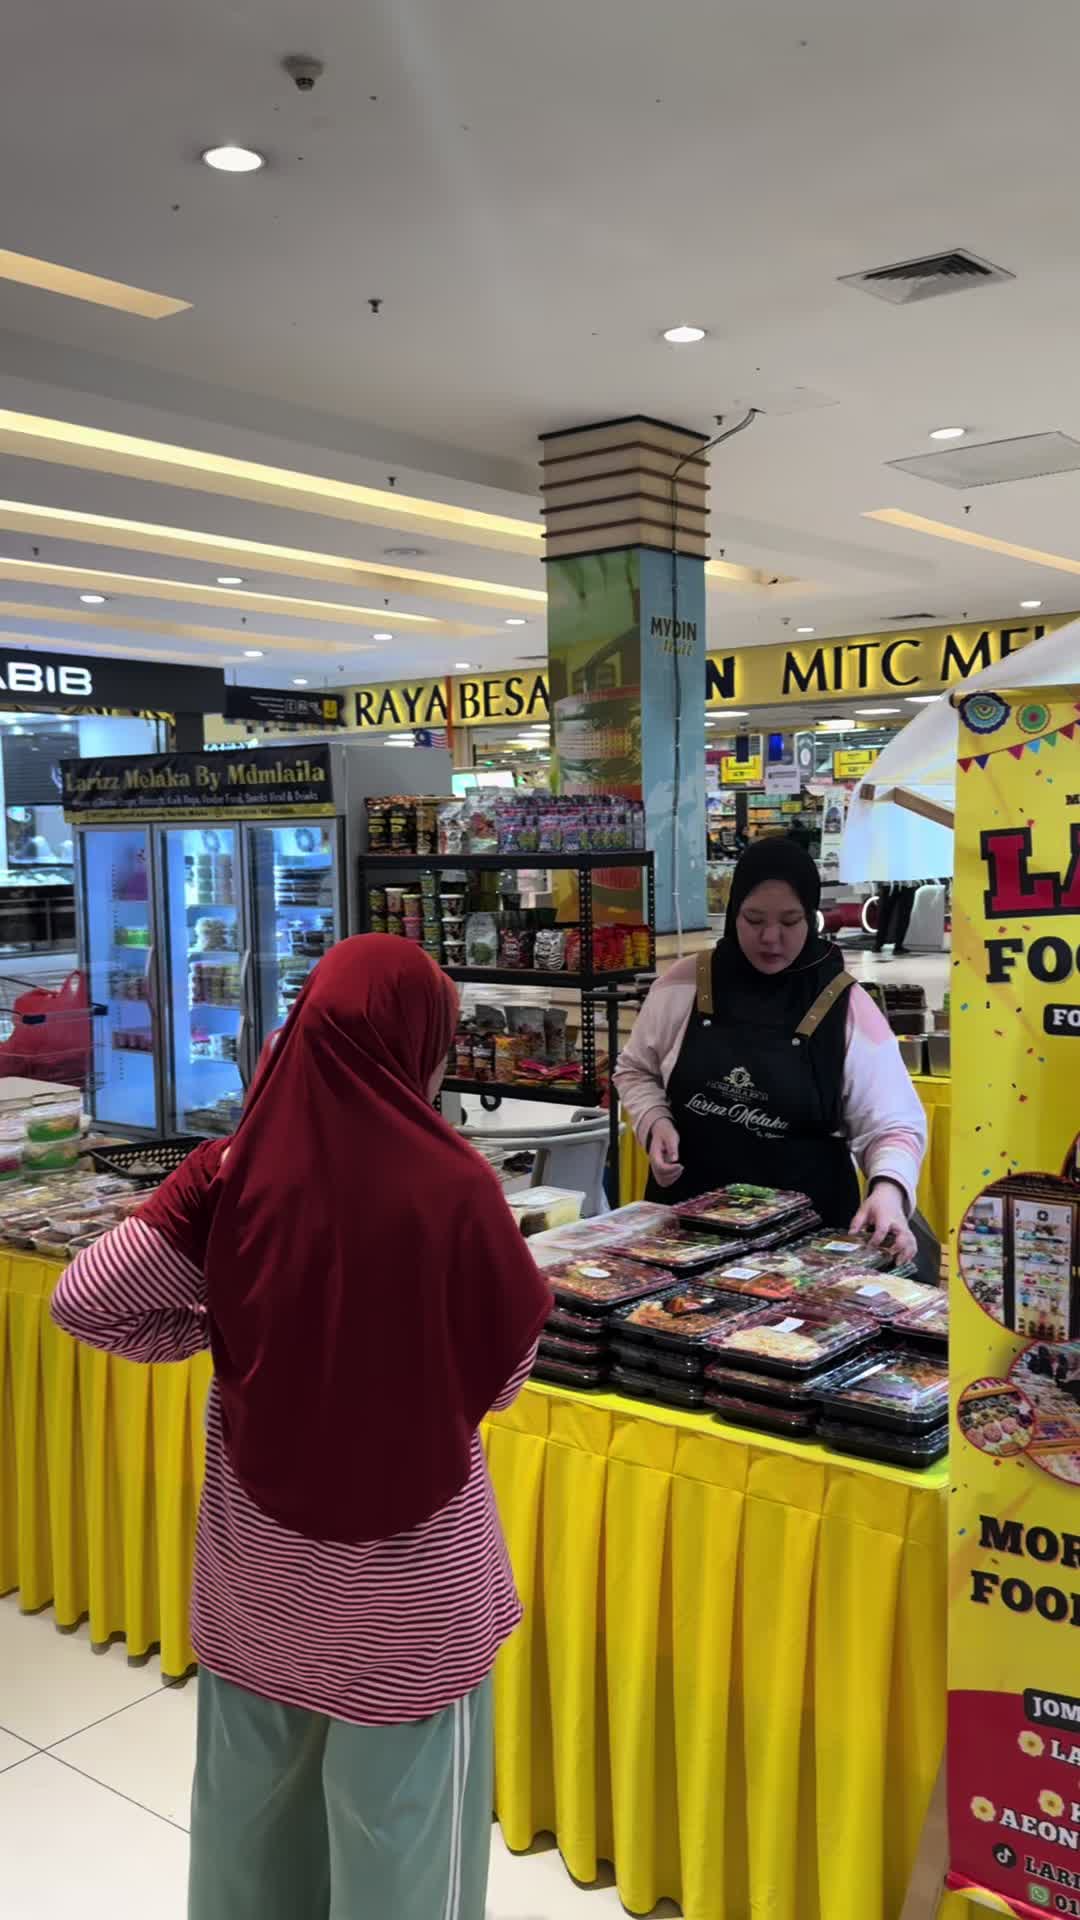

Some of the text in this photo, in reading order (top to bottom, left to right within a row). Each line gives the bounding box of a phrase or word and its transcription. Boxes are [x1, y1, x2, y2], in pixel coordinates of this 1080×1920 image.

[651, 616, 697, 641] MYDIN
[0, 661, 93, 696] BIB
[355, 684, 448, 726] RAYA
[781, 639, 923, 695] MITC
[940, 625, 1045, 681] ME
[65, 760, 326, 792] Larizz Melaka By Mdmlaila
[984, 936, 1080, 984] FO
[684, 1092, 789, 1131] Larizz Melaka
[1032, 1696, 1080, 1722] JOM
[999, 1807, 1079, 1849] AEON
